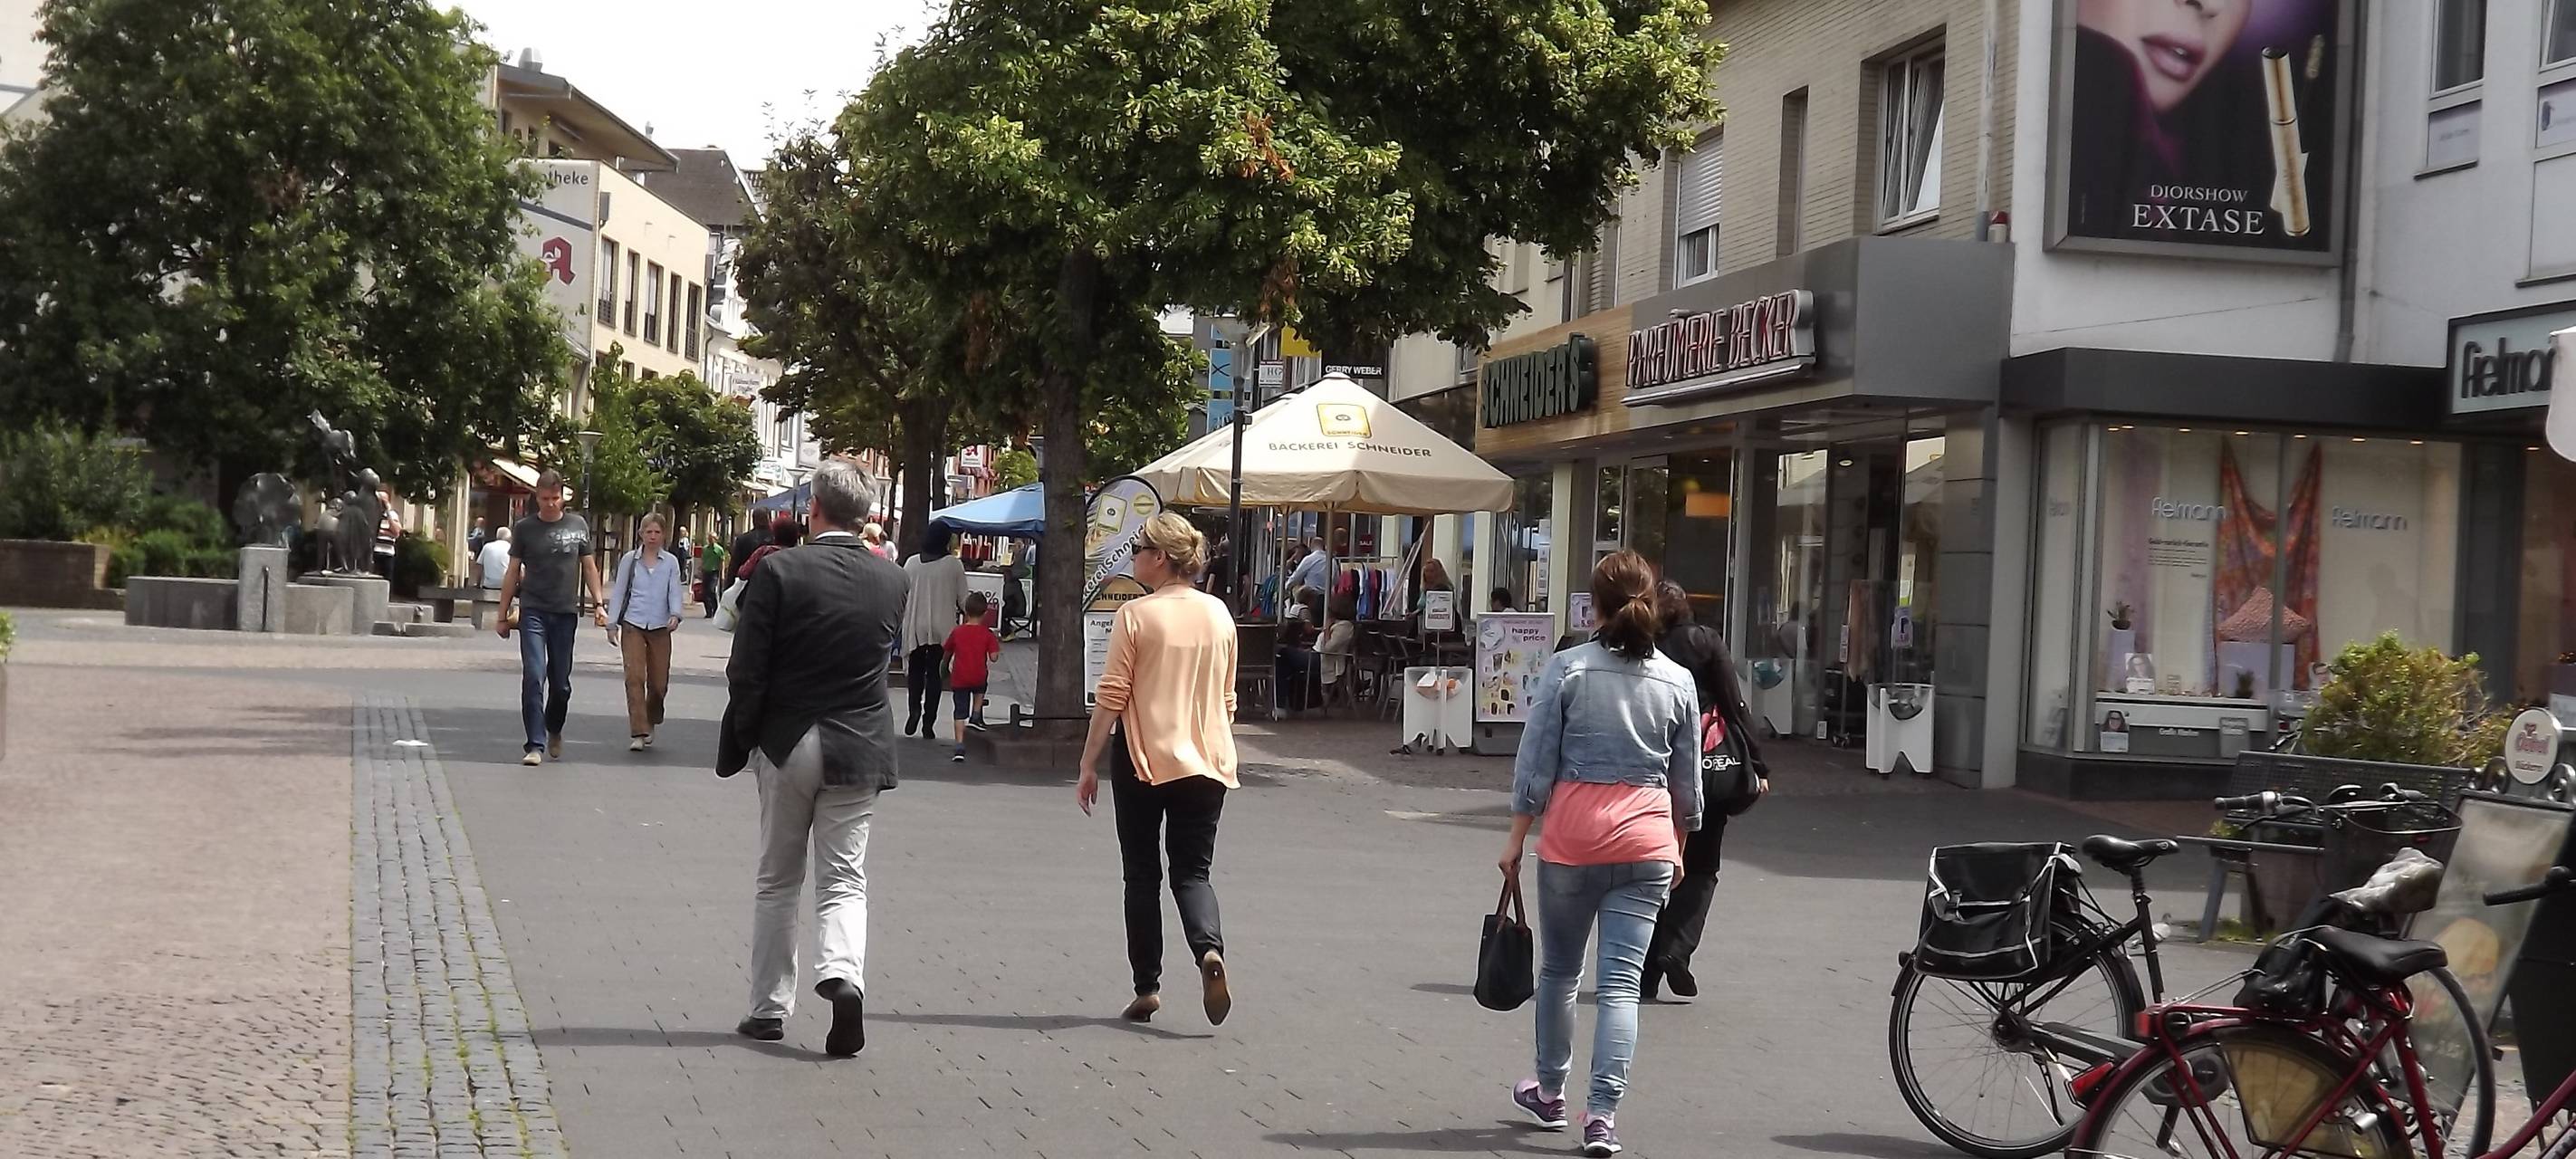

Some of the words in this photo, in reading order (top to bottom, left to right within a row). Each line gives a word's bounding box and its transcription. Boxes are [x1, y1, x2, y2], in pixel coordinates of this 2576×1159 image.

[2150, 185, 2247, 203] DIORSHOW
[2131, 204, 2265, 235] EXTASE
[1728, 290, 1807, 369] BECKER
[1353, 367, 1383, 376] WEBER
[1347, 441, 1432, 457] SCHNEIDER
